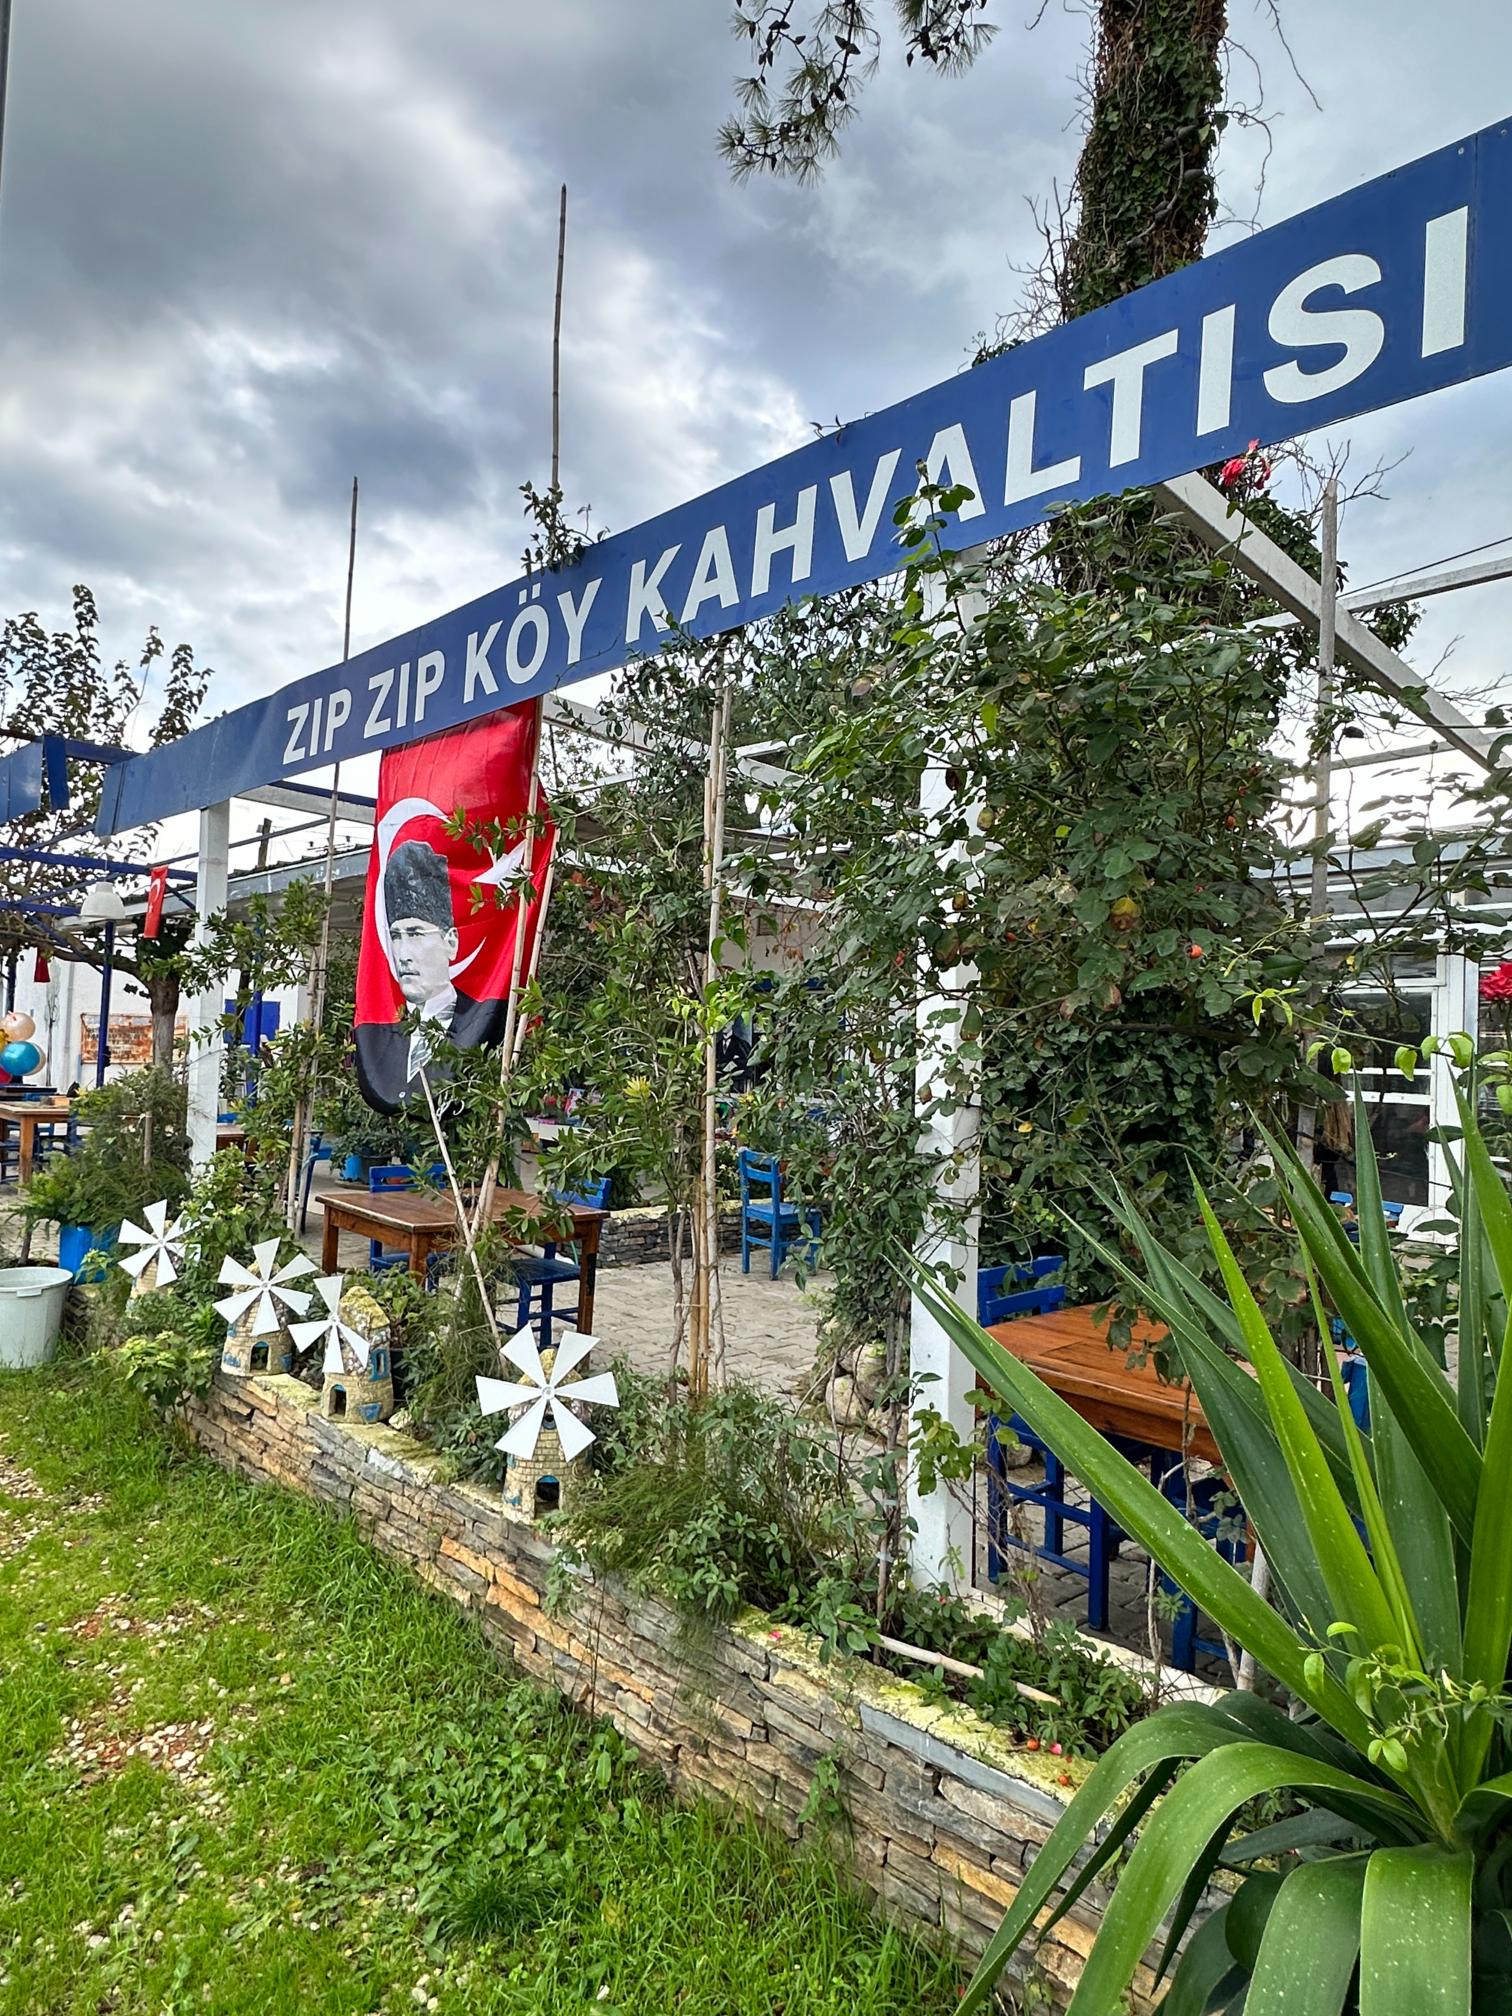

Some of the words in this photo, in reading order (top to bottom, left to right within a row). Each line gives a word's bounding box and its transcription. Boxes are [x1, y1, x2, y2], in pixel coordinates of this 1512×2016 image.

[283, 688, 351, 764] ZIP
[363, 650, 445, 739] ZIP
[463, 577, 603, 704] KÖY
[625, 205, 1468, 644] KAHVALTISI
